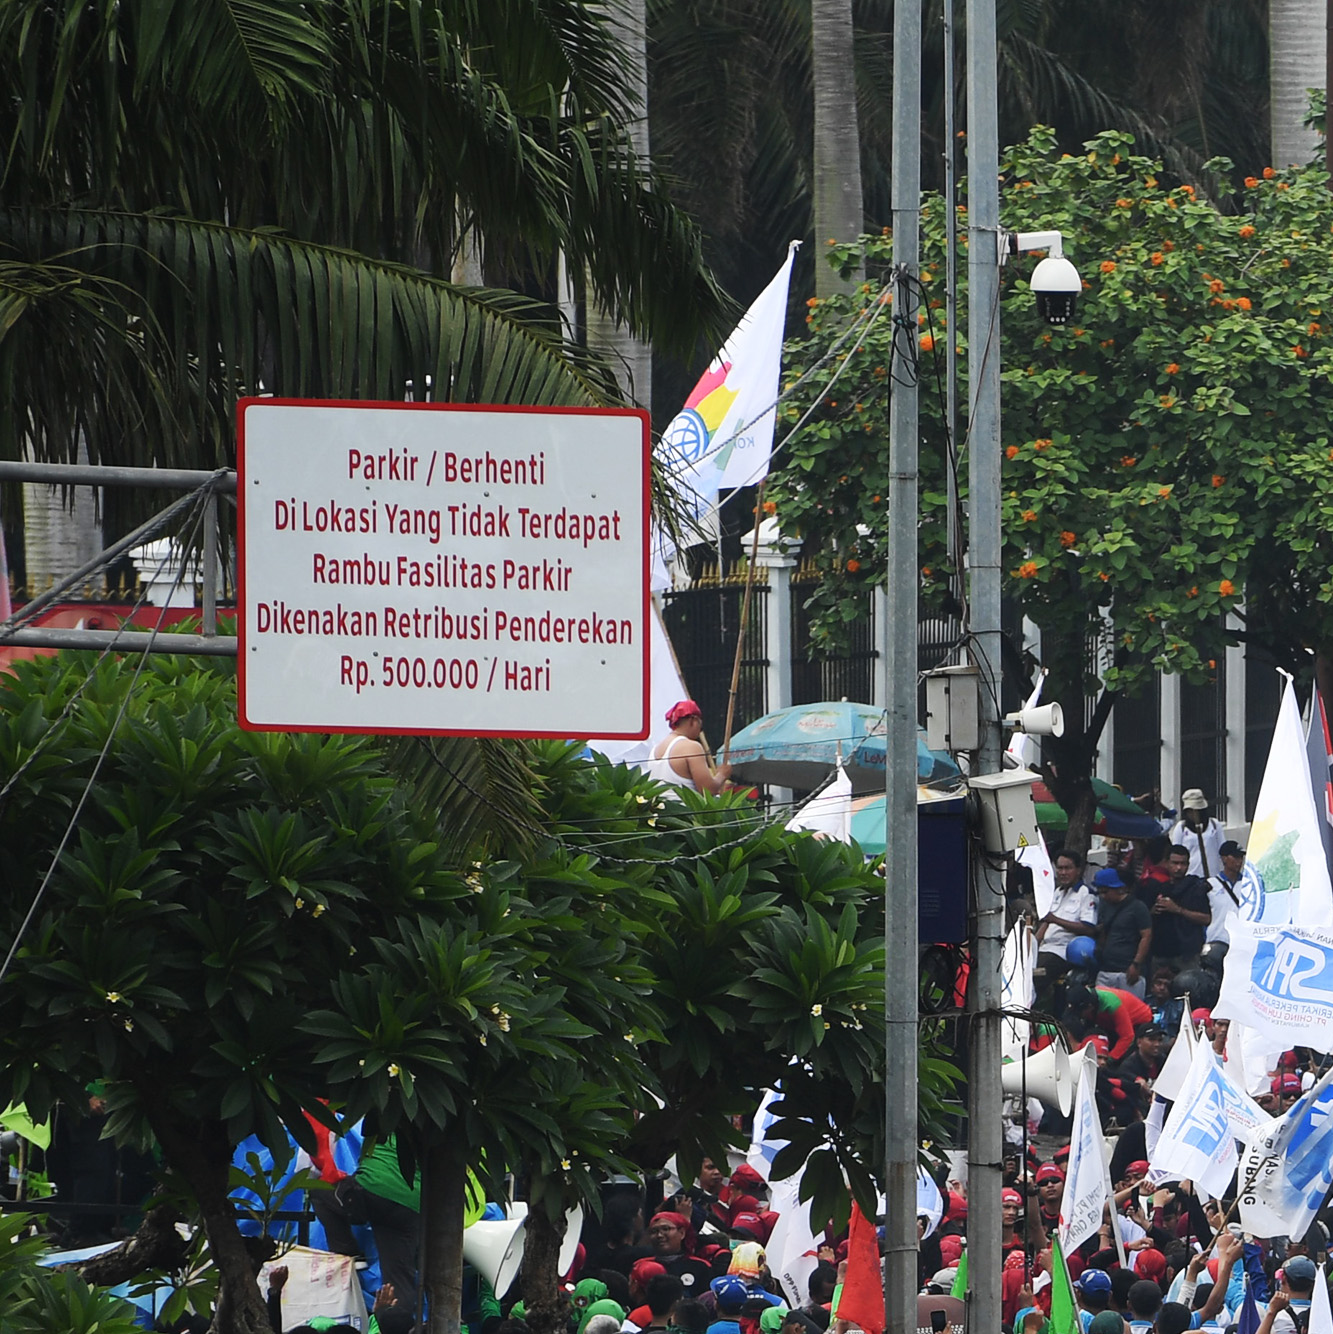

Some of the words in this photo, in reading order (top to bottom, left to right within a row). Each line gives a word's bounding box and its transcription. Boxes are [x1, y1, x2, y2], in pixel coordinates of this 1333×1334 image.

[348, 448, 418, 482] Parkir
[425, 450, 437, 487] /
[444, 451, 545, 486] Berhenti
[274, 497, 296, 531] Di
[303, 499, 377, 534] Lokasi
[385, 503, 441, 544] Yang
[447, 503, 511, 538] Tidak
[518, 507, 621, 548] Terdapat
[313, 552, 391, 586] Rambu
[397, 554, 496, 589] Fasilitas
[503, 558, 573, 592] Parkir
[257, 600, 377, 637] Dikenakan
[384, 605, 488, 641] Retribusi
[495, 610, 633, 645] Penderekan
[340, 655, 375, 694] Rp.
[382, 656, 479, 690] 500.000
[486, 656, 498, 692] /
[505, 658, 551, 692] Hari
